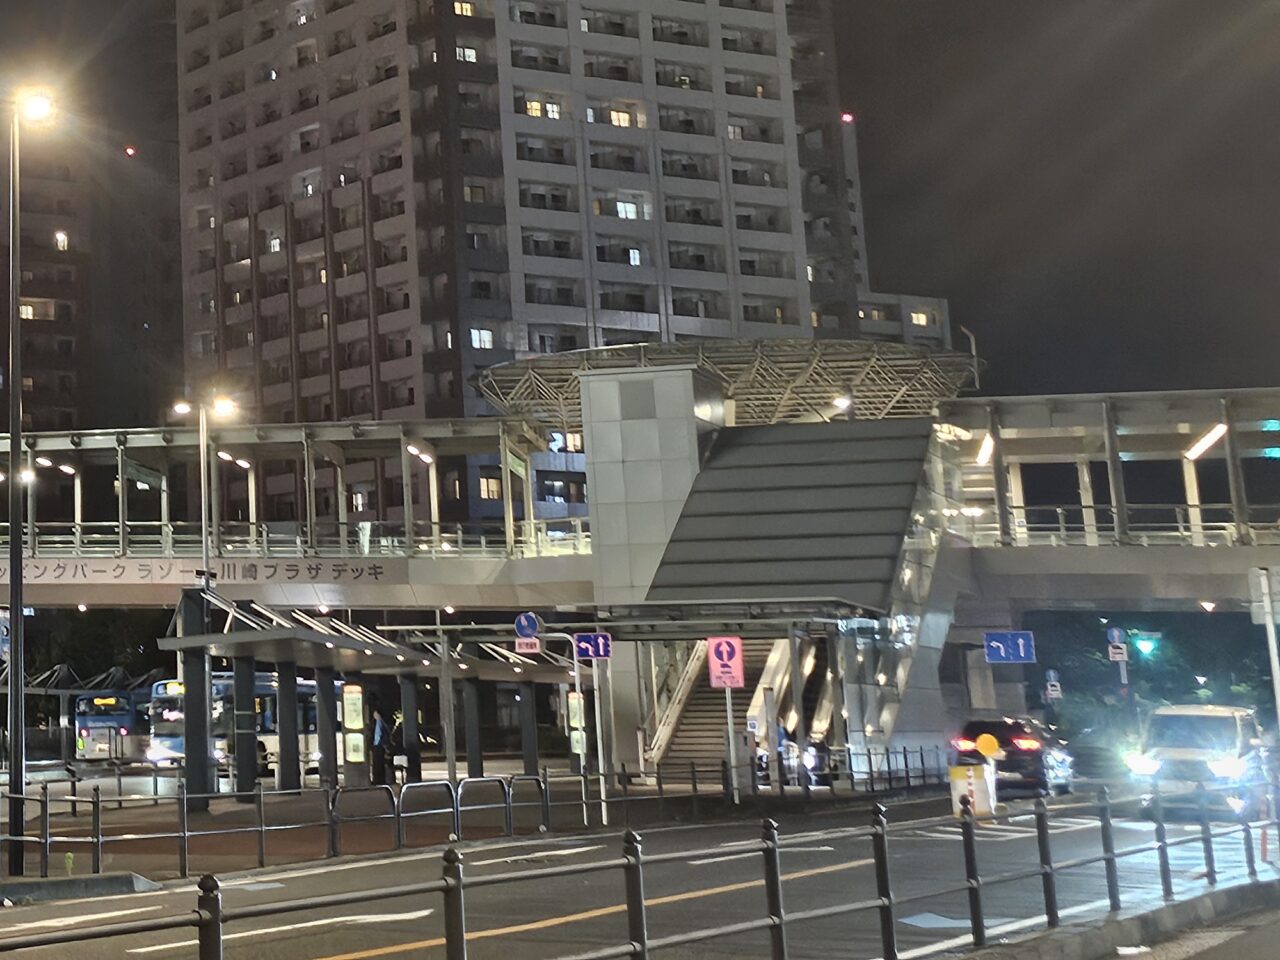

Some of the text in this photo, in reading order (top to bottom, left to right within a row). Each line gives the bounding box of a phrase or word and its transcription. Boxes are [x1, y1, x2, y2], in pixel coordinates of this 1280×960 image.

[137, 562, 322, 581] ラゾー川崎プラザ
